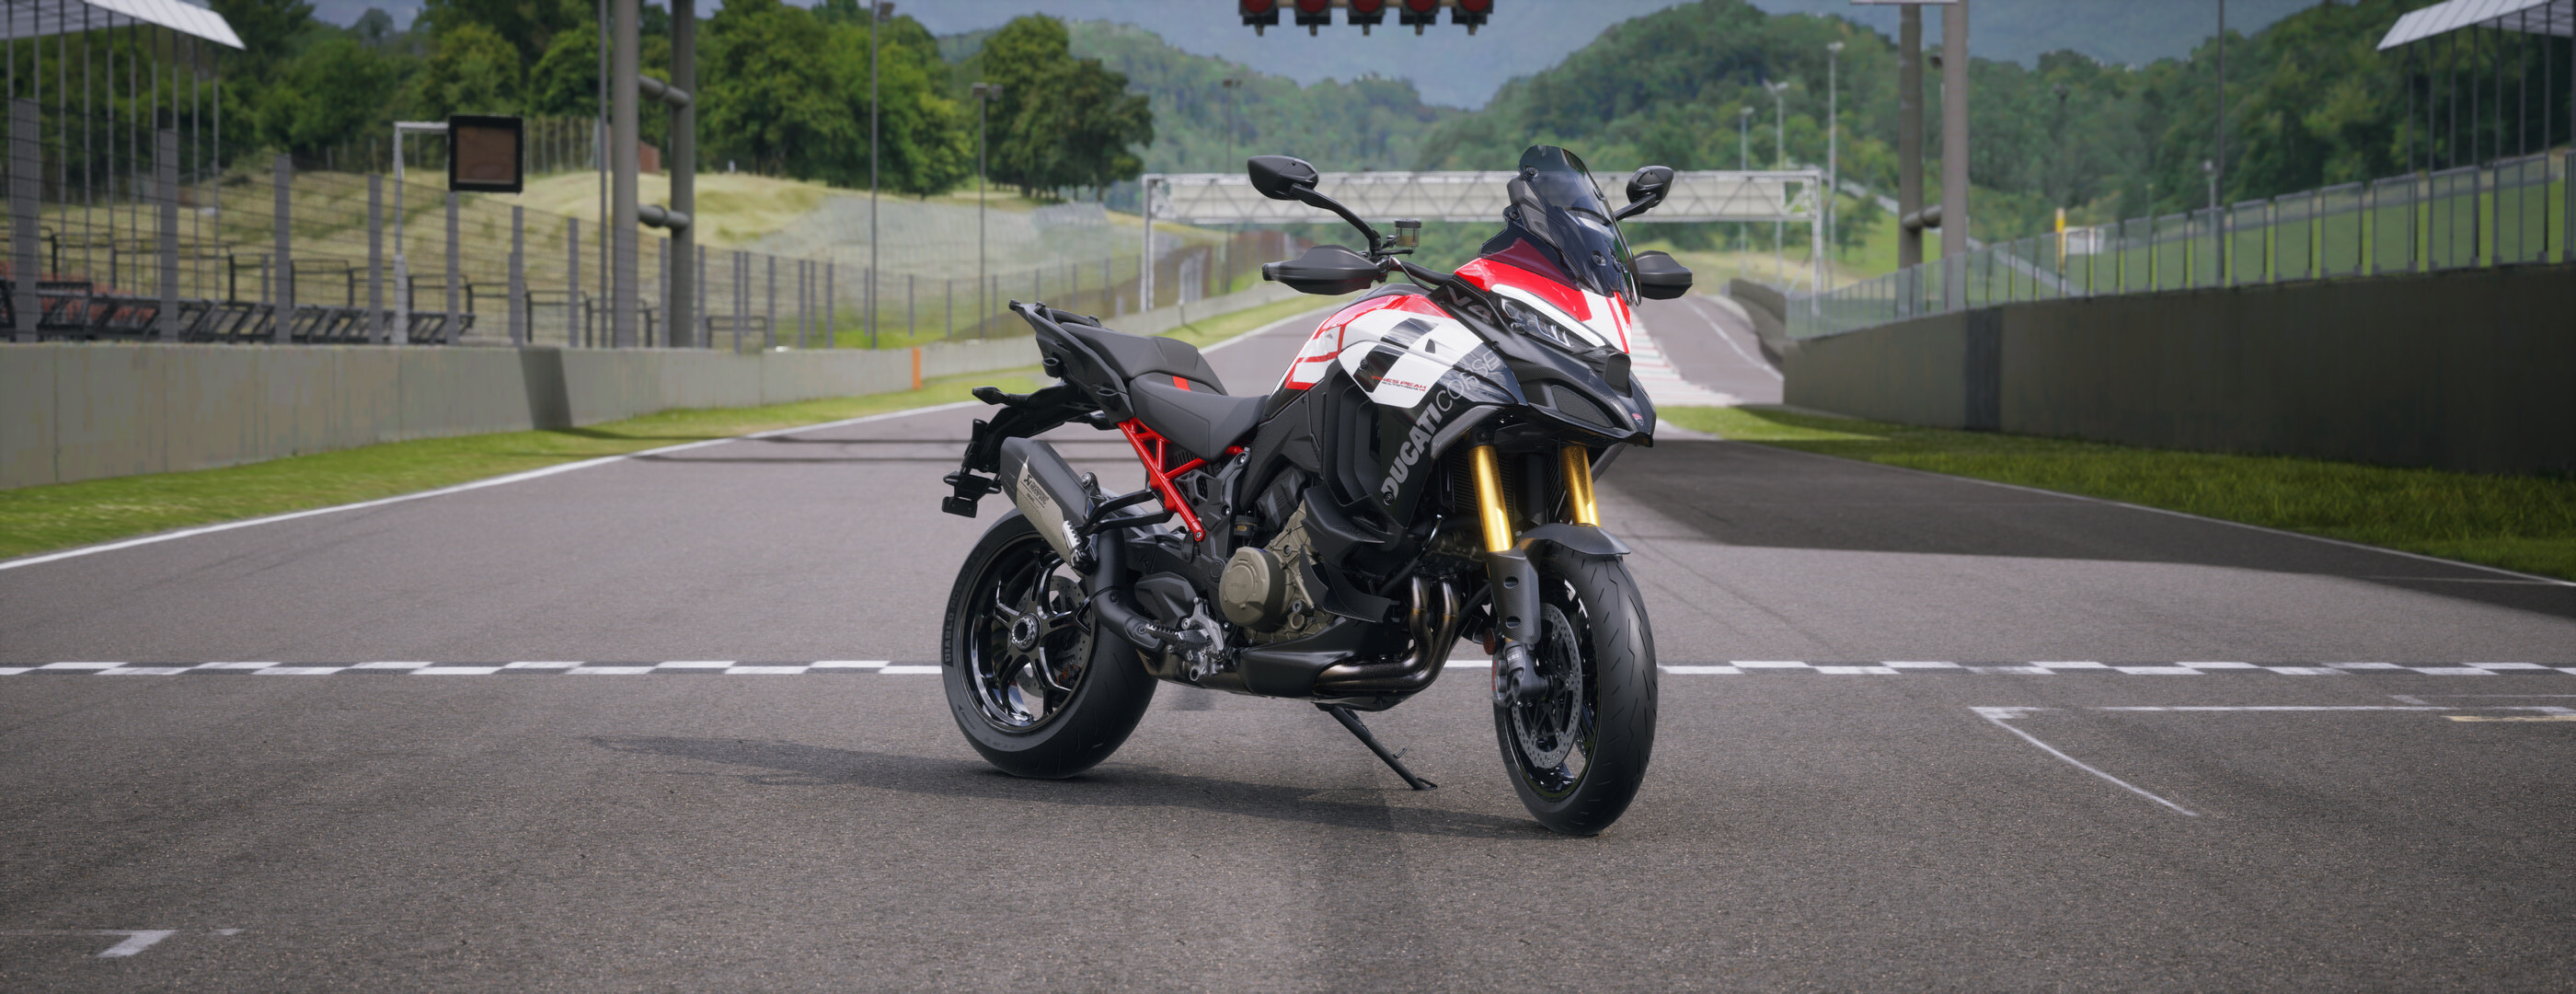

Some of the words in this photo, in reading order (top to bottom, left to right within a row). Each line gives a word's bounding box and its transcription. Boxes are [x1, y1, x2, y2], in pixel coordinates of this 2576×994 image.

[1446, 284, 1494, 325] V4
[1381, 402, 1443, 500] DUCATI
[1436, 351, 1501, 411] CORSE
[944, 613, 955, 663] DIABLO
